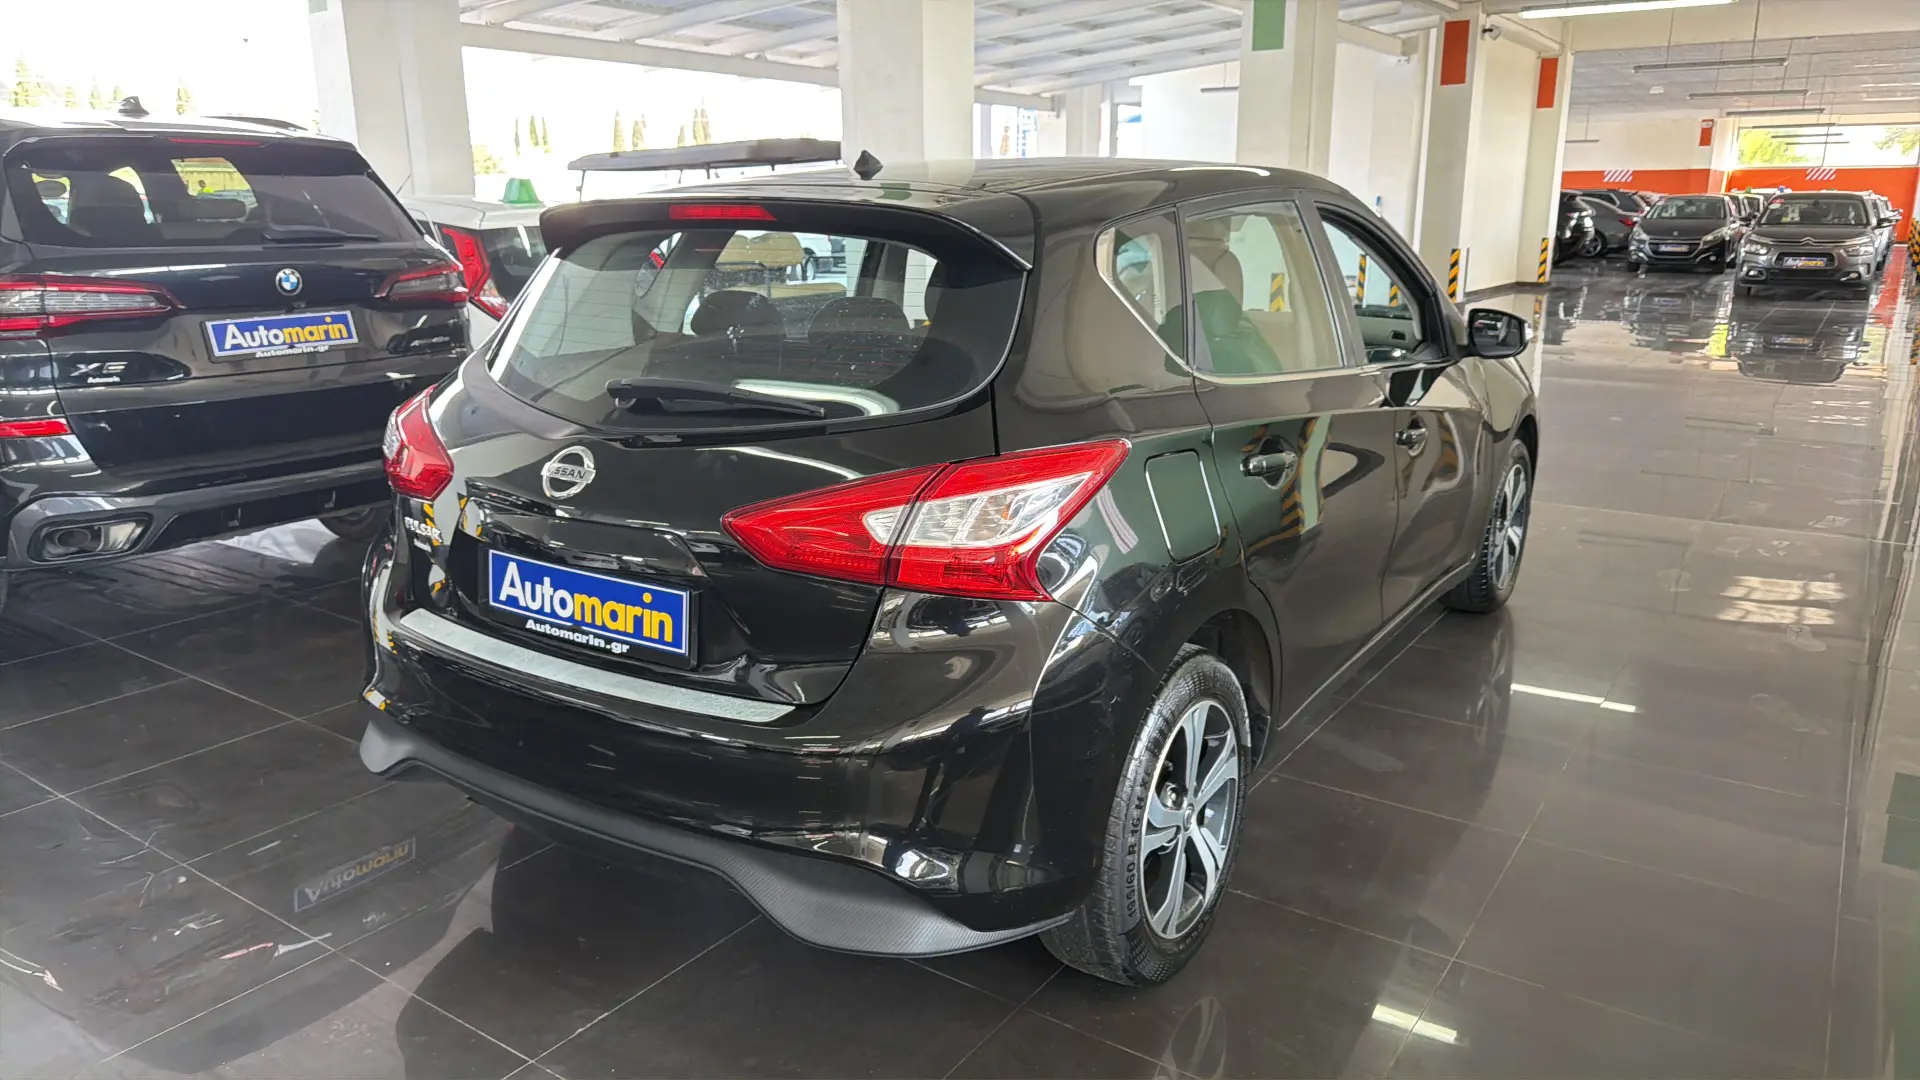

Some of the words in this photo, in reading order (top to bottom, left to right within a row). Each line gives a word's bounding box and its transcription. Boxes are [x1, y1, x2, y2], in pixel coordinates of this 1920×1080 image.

[224, 316, 348, 350] Automarin
[255, 345, 330, 358] Automarin.gr
[499, 561, 673, 643] Automarin
[526, 619, 630, 654] Automarin.gr
[1130, 816, 1141, 835] 16
[1126, 842, 1137, 857] R
[1124, 862, 1138, 918] 195/60
